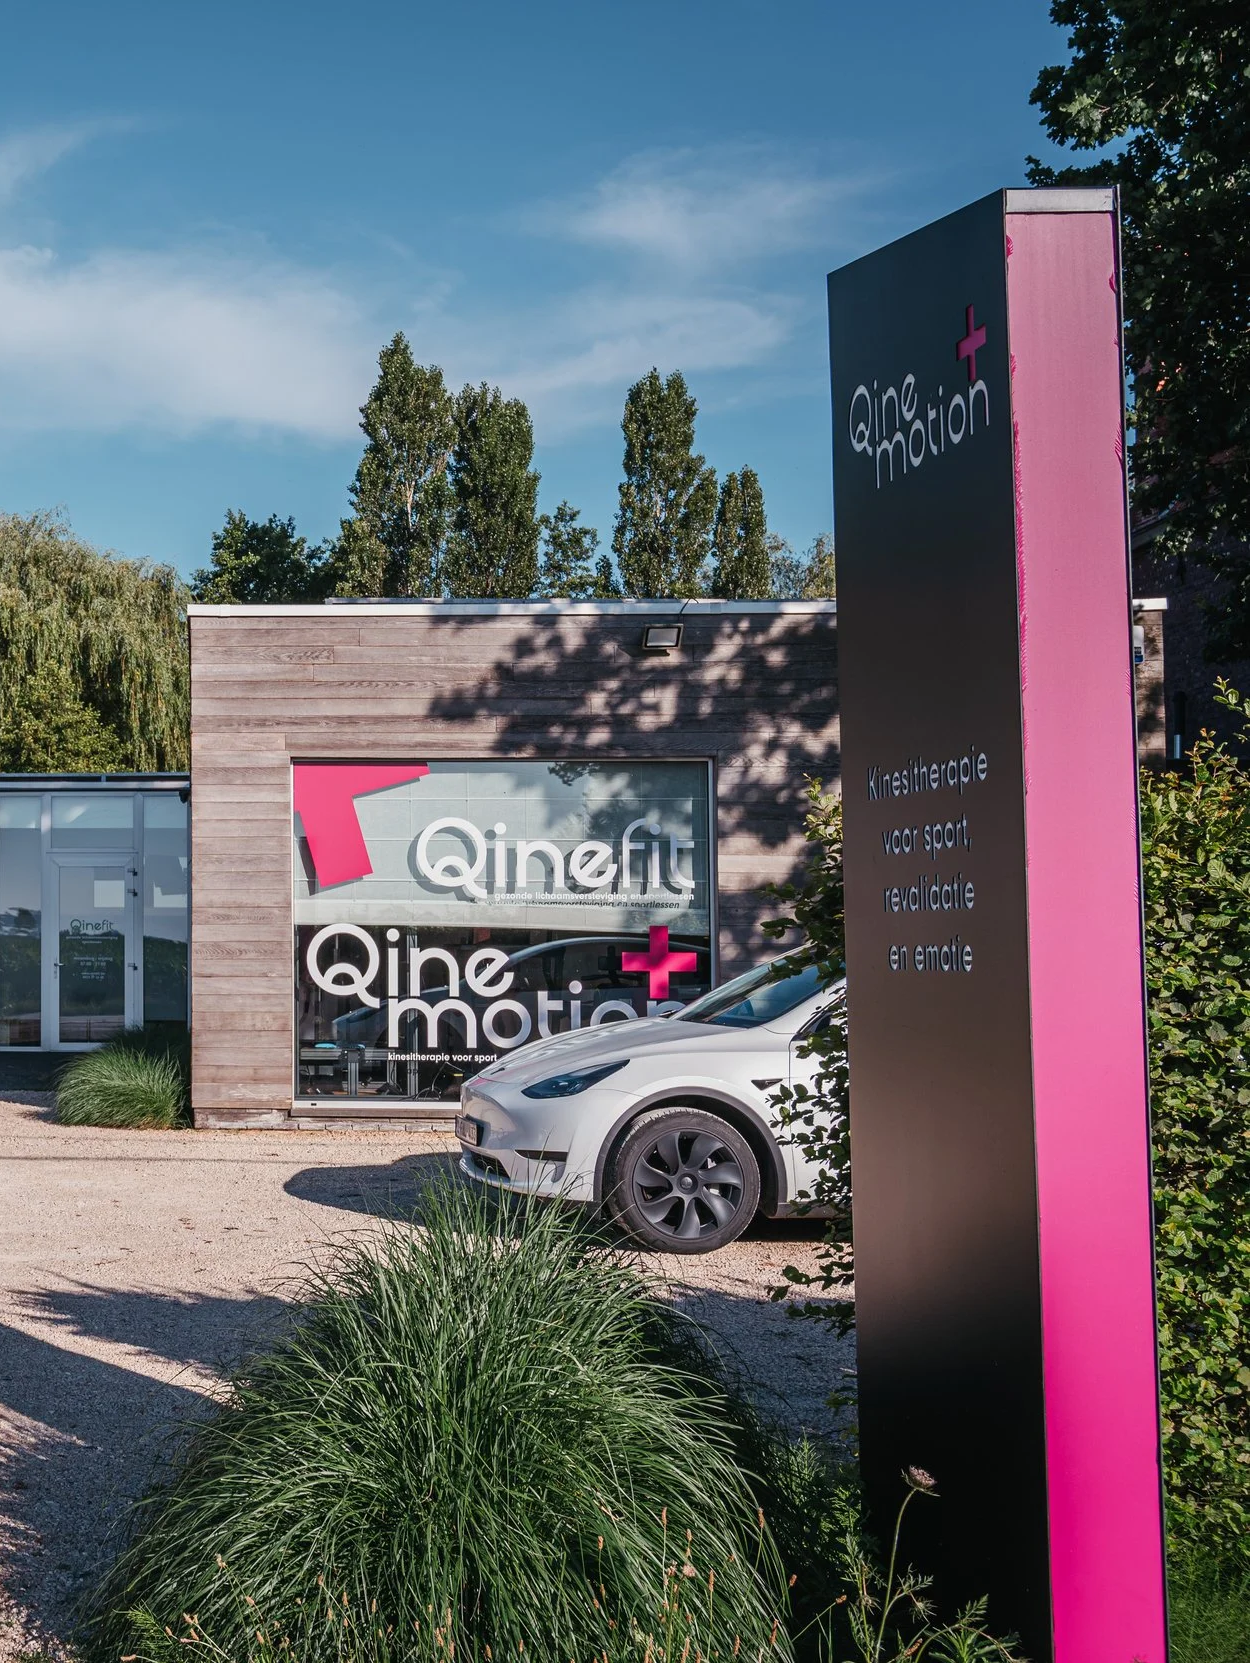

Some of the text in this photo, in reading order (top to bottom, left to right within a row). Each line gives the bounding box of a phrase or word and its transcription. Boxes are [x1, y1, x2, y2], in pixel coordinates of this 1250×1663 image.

[850, 373, 918, 456] Qine
[876, 379, 989, 489] motion
[867, 745, 988, 800] Kinesitherapie
[416, 817, 695, 898] Qinefit
[882, 813, 972, 860] voor sport,
[494, 892, 532, 901] gezonde
[535, 892, 627, 901] lichaamsversteviging
[884, 872, 975, 912] revalidatie
[306, 923, 515, 1009] Qine
[889, 934, 973, 972] en emotie
[388, 1052, 450, 1063] kinesitherapie
[474, 1053, 497, 1063] sport
